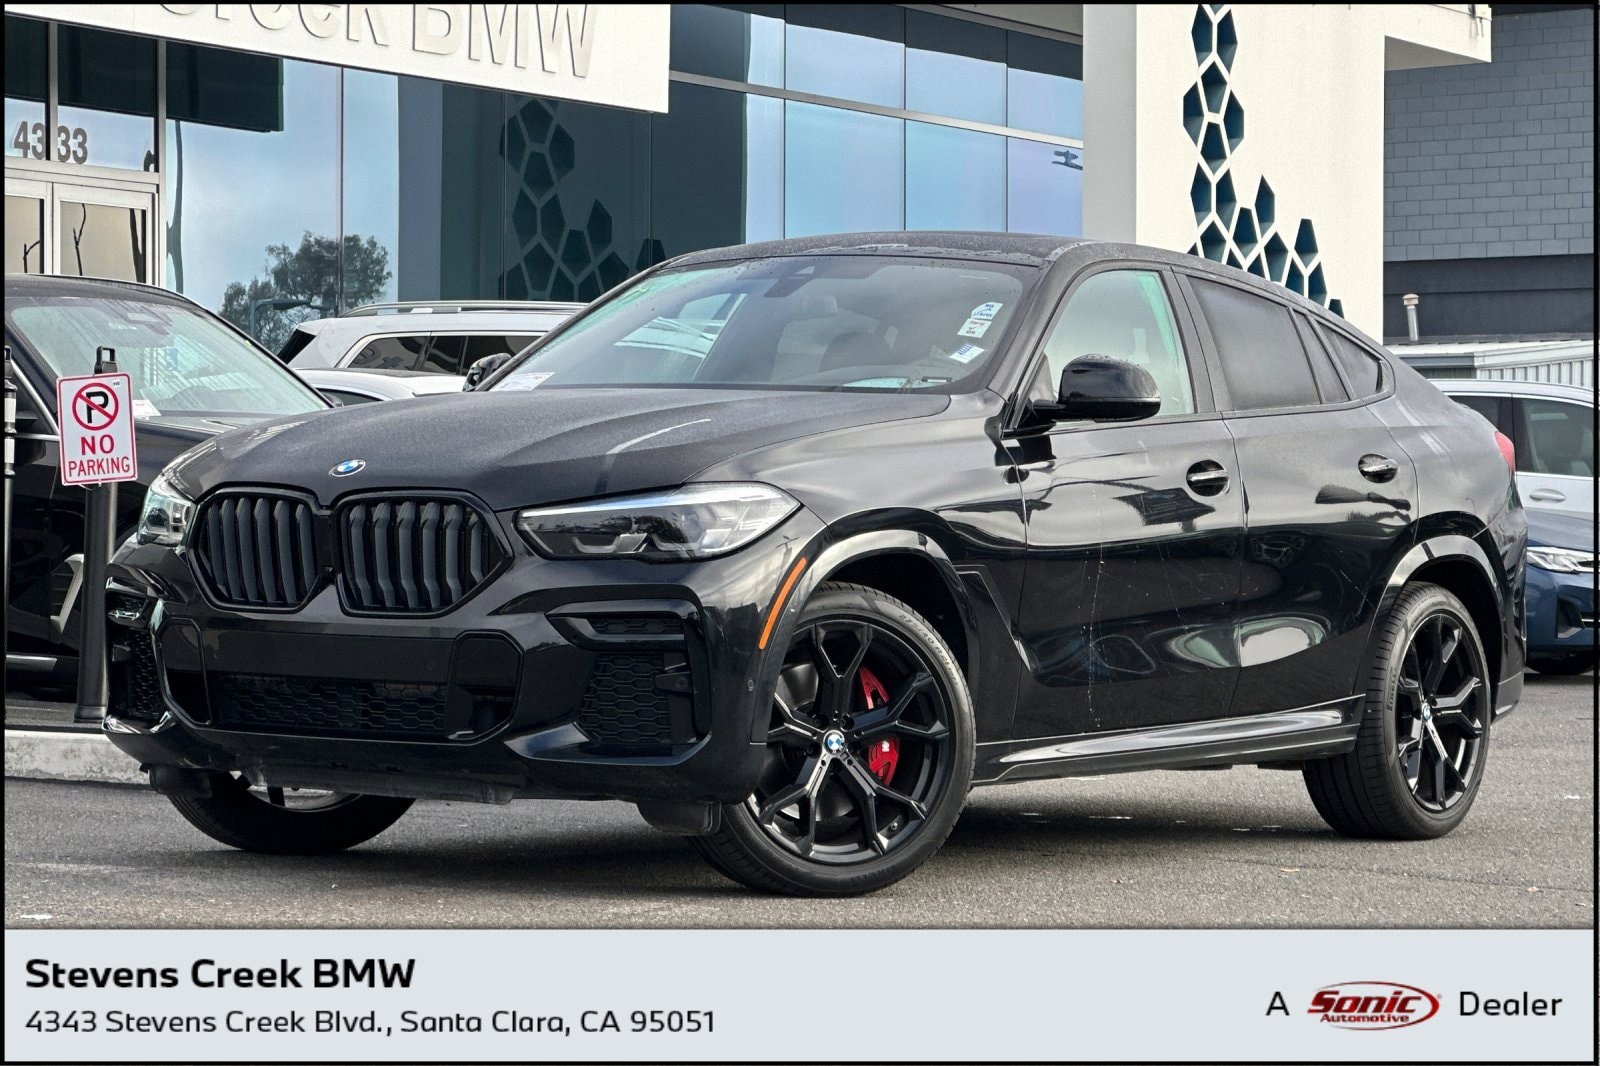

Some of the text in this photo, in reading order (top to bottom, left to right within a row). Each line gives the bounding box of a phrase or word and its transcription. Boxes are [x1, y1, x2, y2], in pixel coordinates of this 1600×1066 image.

[412, 4, 599, 79] BMW
[80, 434, 115, 456] NO
[68, 456, 131, 477] PARKING
